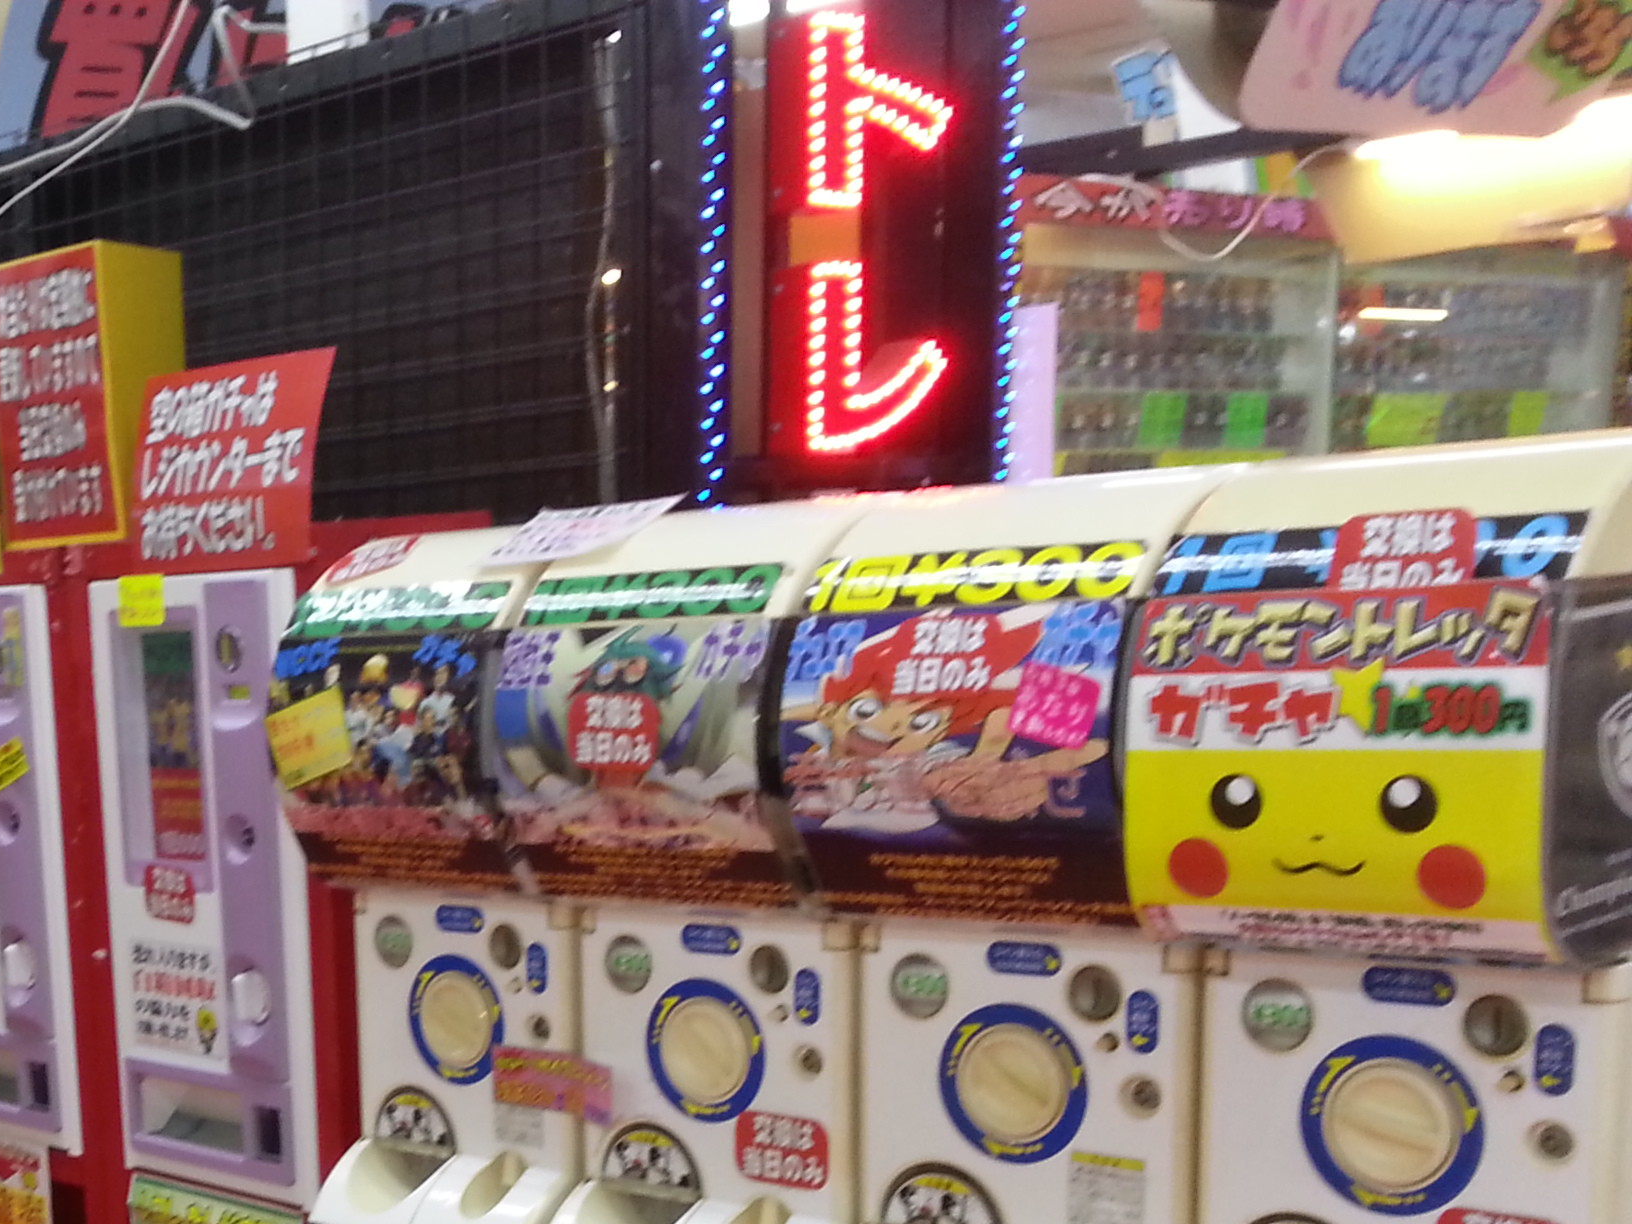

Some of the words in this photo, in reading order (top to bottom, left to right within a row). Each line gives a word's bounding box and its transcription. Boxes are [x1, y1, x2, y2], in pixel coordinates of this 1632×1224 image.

[141, 427, 306, 501] レジカウンターまで
[806, 541, 1146, 612] 1回¥300
[909, 617, 989, 655] 交換は
[1142, 585, 1542, 668] ポケモントレッタ
[890, 656, 992, 695] 当日のみ
[1150, 680, 1338, 747] ガチャ
[751, 1114, 815, 1148] 交換は
[740, 1148, 825, 1188] 当日のみ
